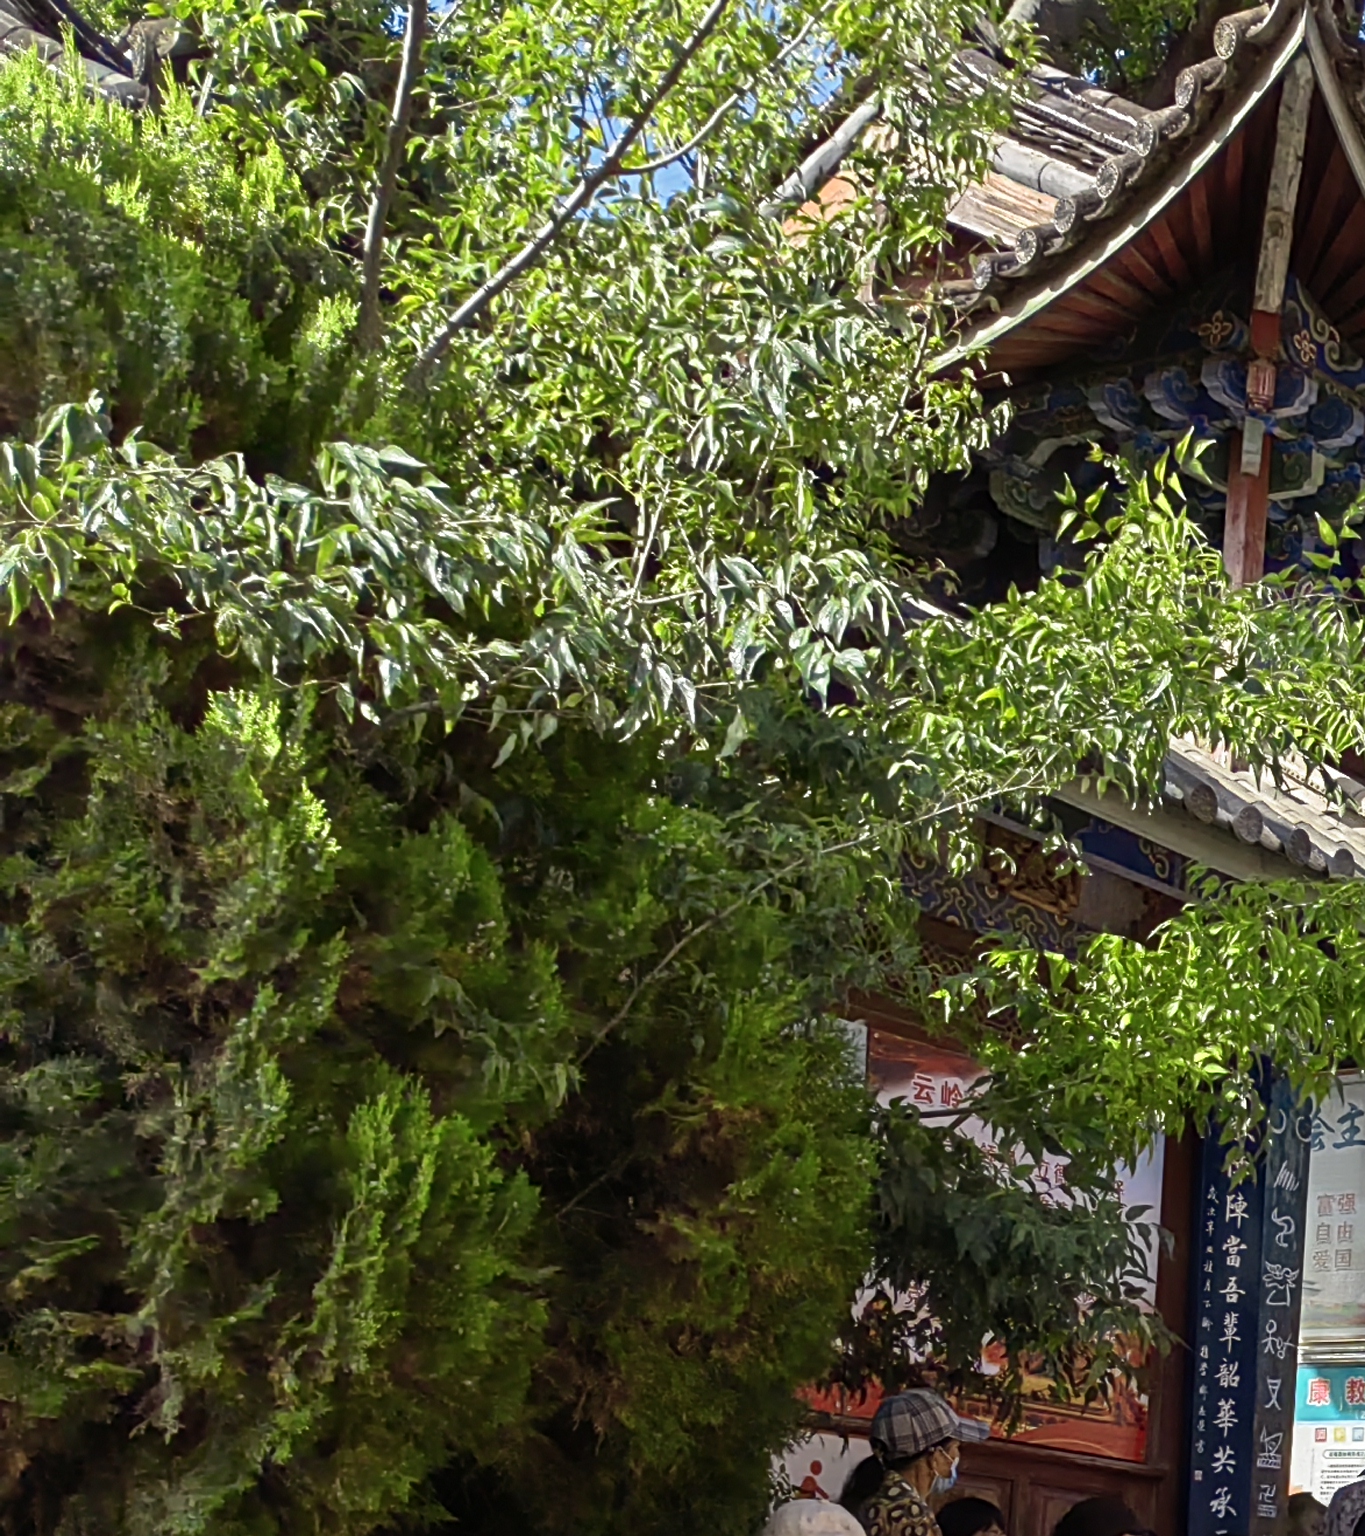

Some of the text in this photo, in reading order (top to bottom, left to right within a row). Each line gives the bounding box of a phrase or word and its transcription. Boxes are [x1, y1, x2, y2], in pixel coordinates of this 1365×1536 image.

[1316, 1193, 1357, 1217] 富强
[1315, 1219, 1353, 1245] 自由
[1312, 1247, 1352, 1270] 爱国
